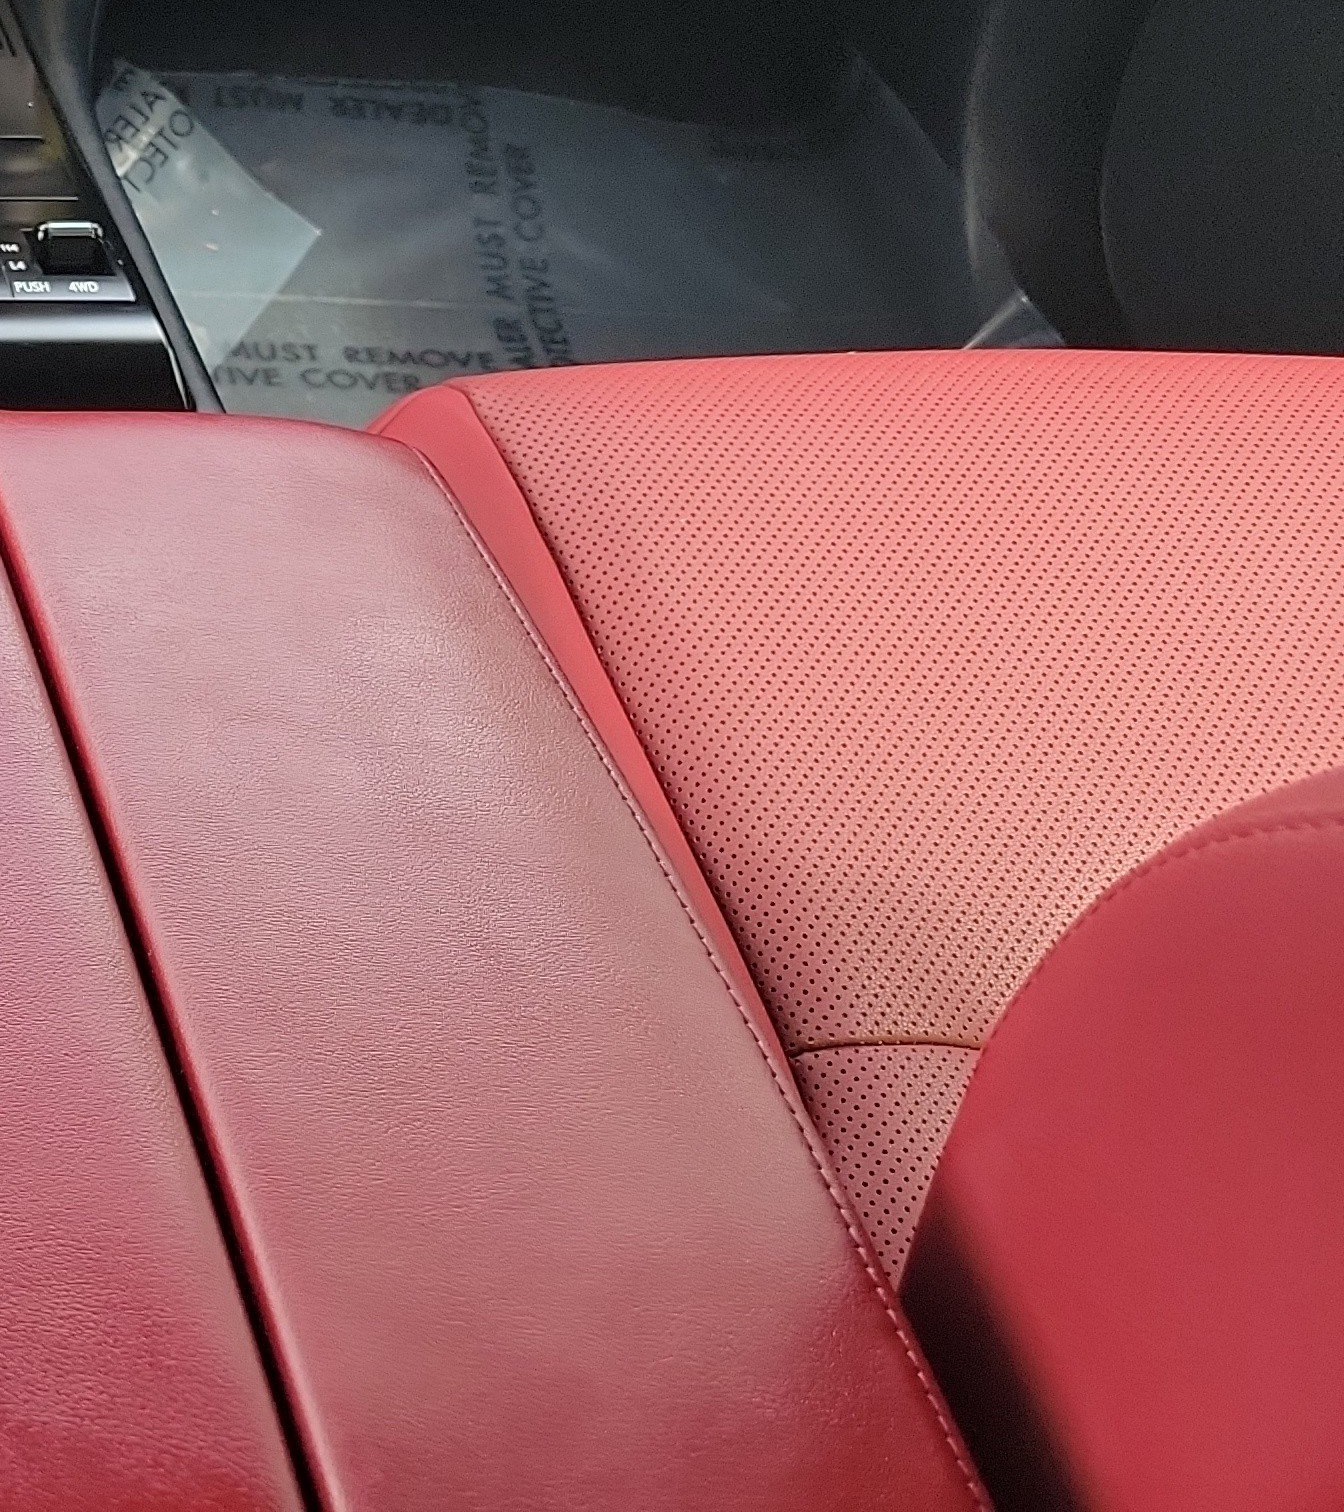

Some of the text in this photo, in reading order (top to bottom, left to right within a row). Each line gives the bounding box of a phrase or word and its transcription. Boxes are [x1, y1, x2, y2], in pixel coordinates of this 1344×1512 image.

[13, 281, 100, 293] PUSH 4WD
[343, 346, 495, 371] REMOVE
